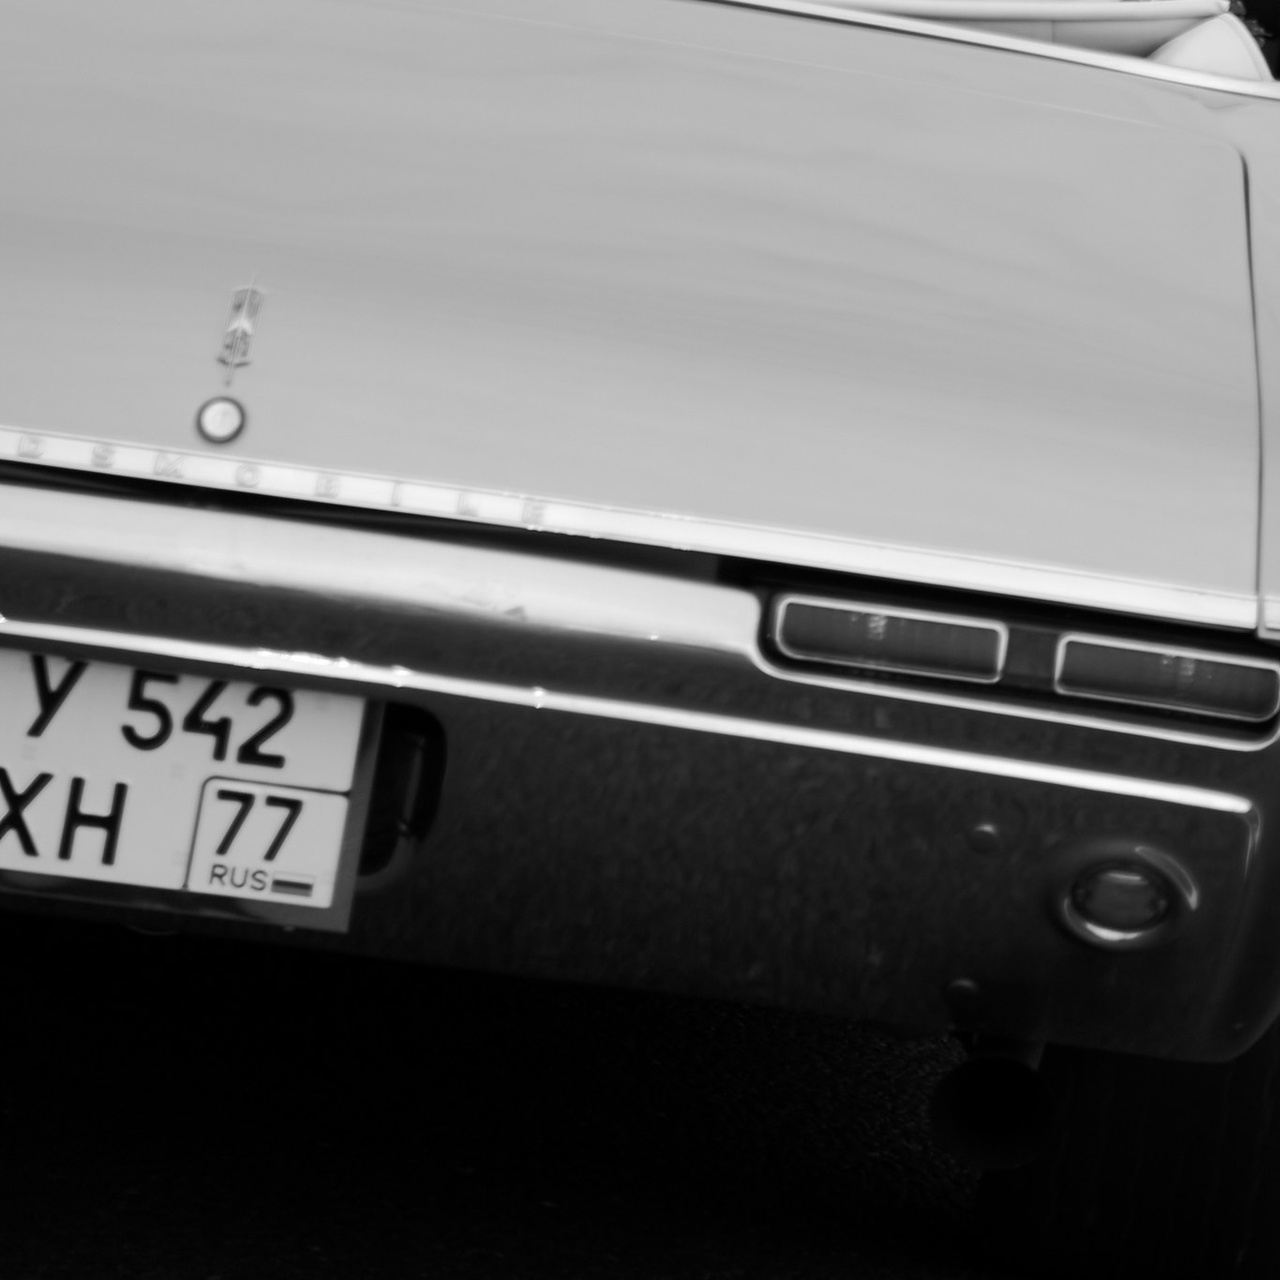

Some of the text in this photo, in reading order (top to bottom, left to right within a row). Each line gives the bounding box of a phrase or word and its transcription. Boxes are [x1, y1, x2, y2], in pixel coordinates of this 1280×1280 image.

[121, 669, 294, 769] 542
[215, 789, 303, 861] 77
[207, 863, 269, 892] RUS
